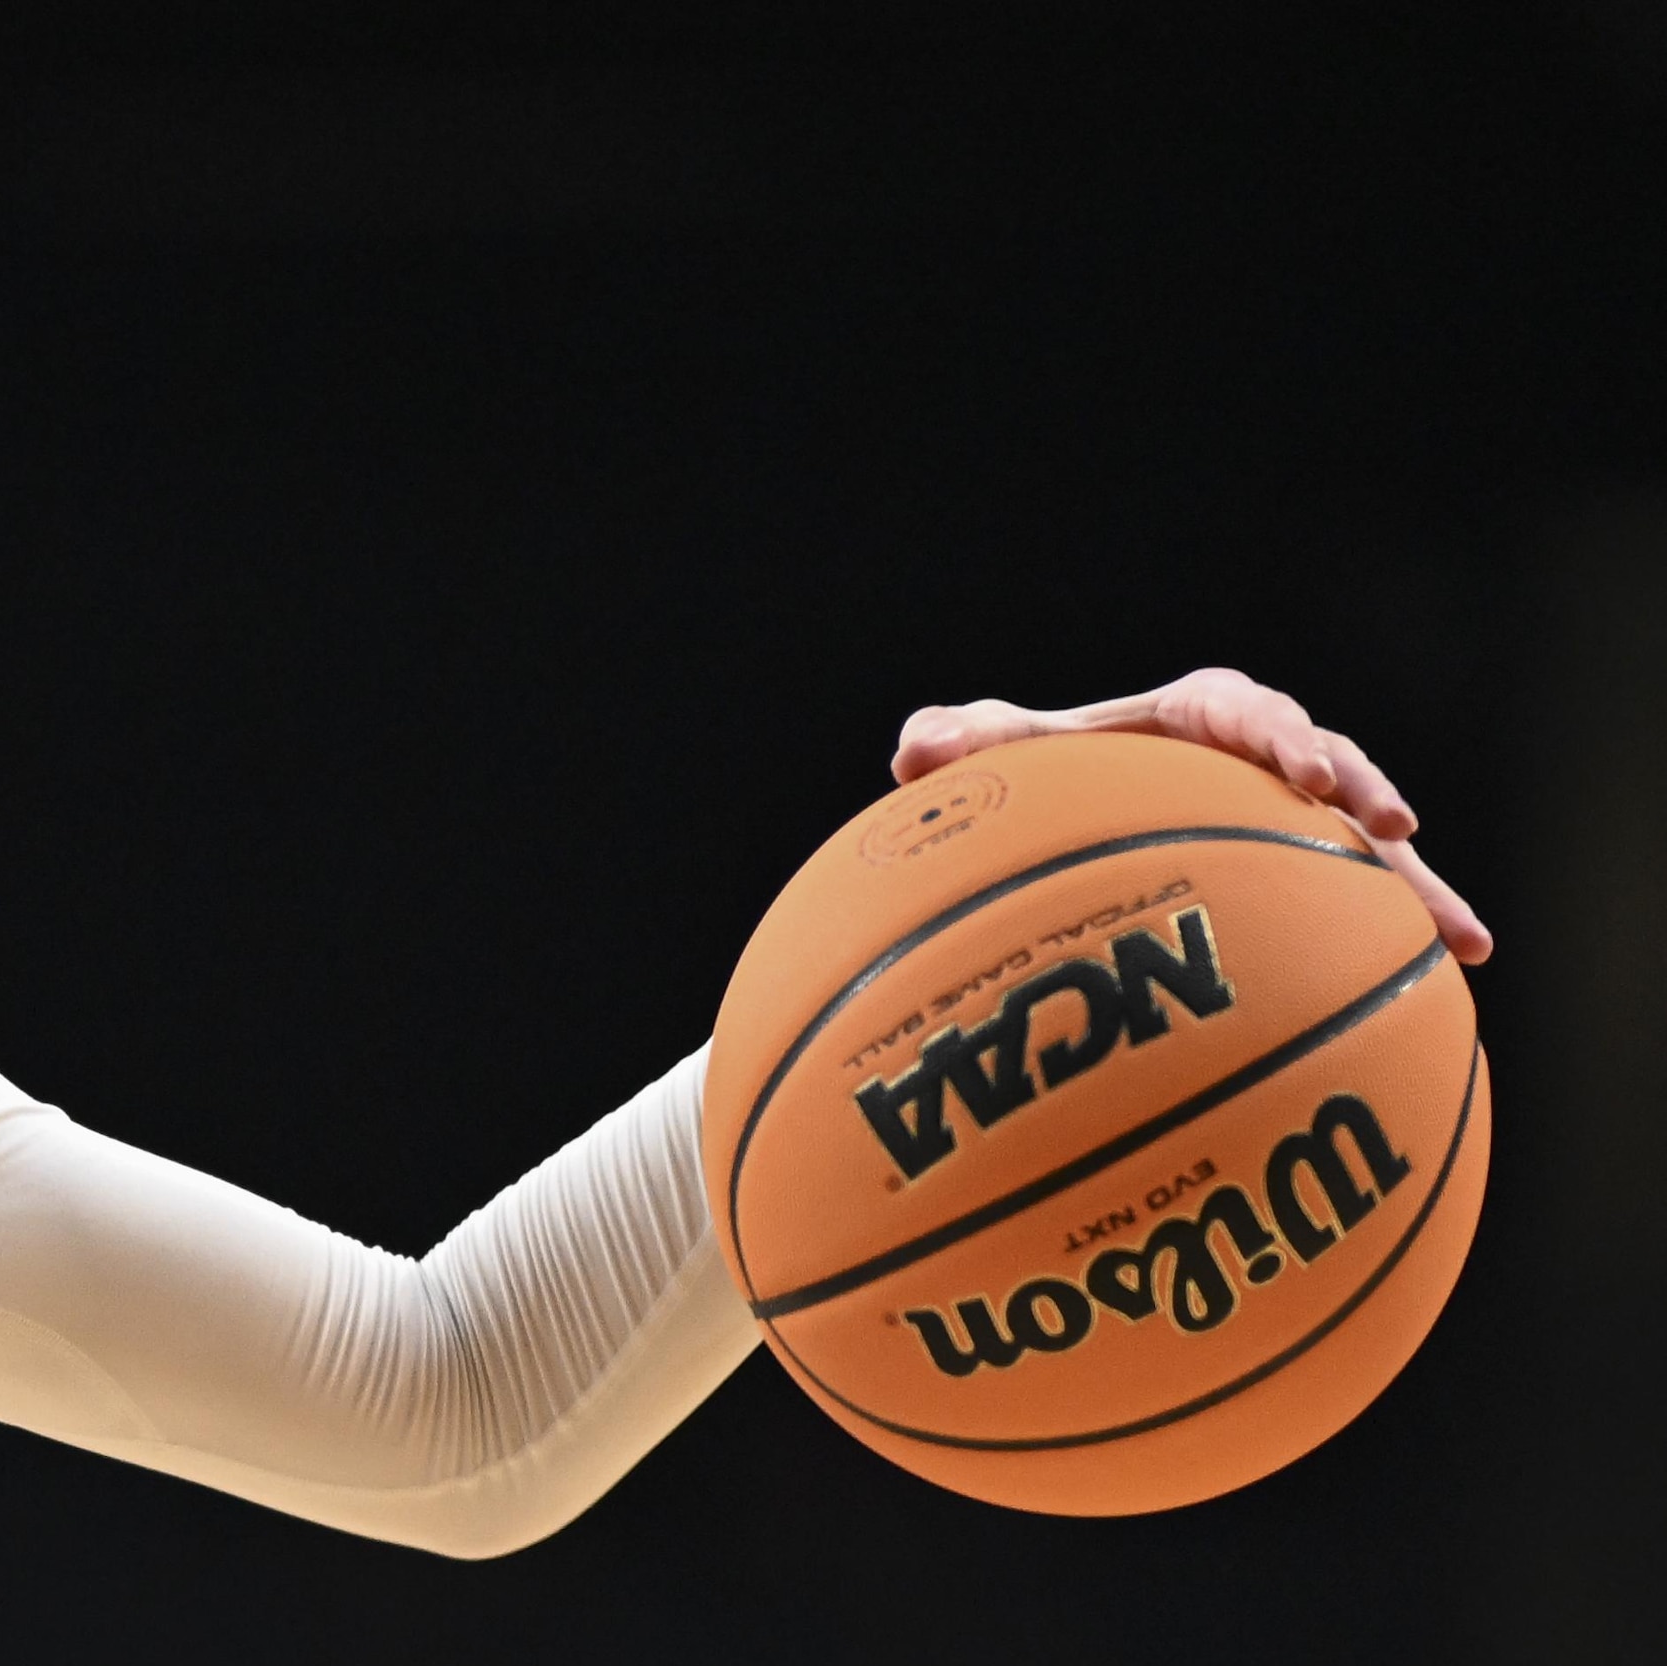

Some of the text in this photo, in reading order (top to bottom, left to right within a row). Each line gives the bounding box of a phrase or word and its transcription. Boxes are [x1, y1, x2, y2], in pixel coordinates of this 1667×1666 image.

[842, 877, 1194, 1069] OFFICIAL GAME BALL
[854, 903, 1237, 1183] NCAA
[903, 1091, 1413, 1378] Wilson
[1065, 1157, 1218, 1254] EVO NXT
